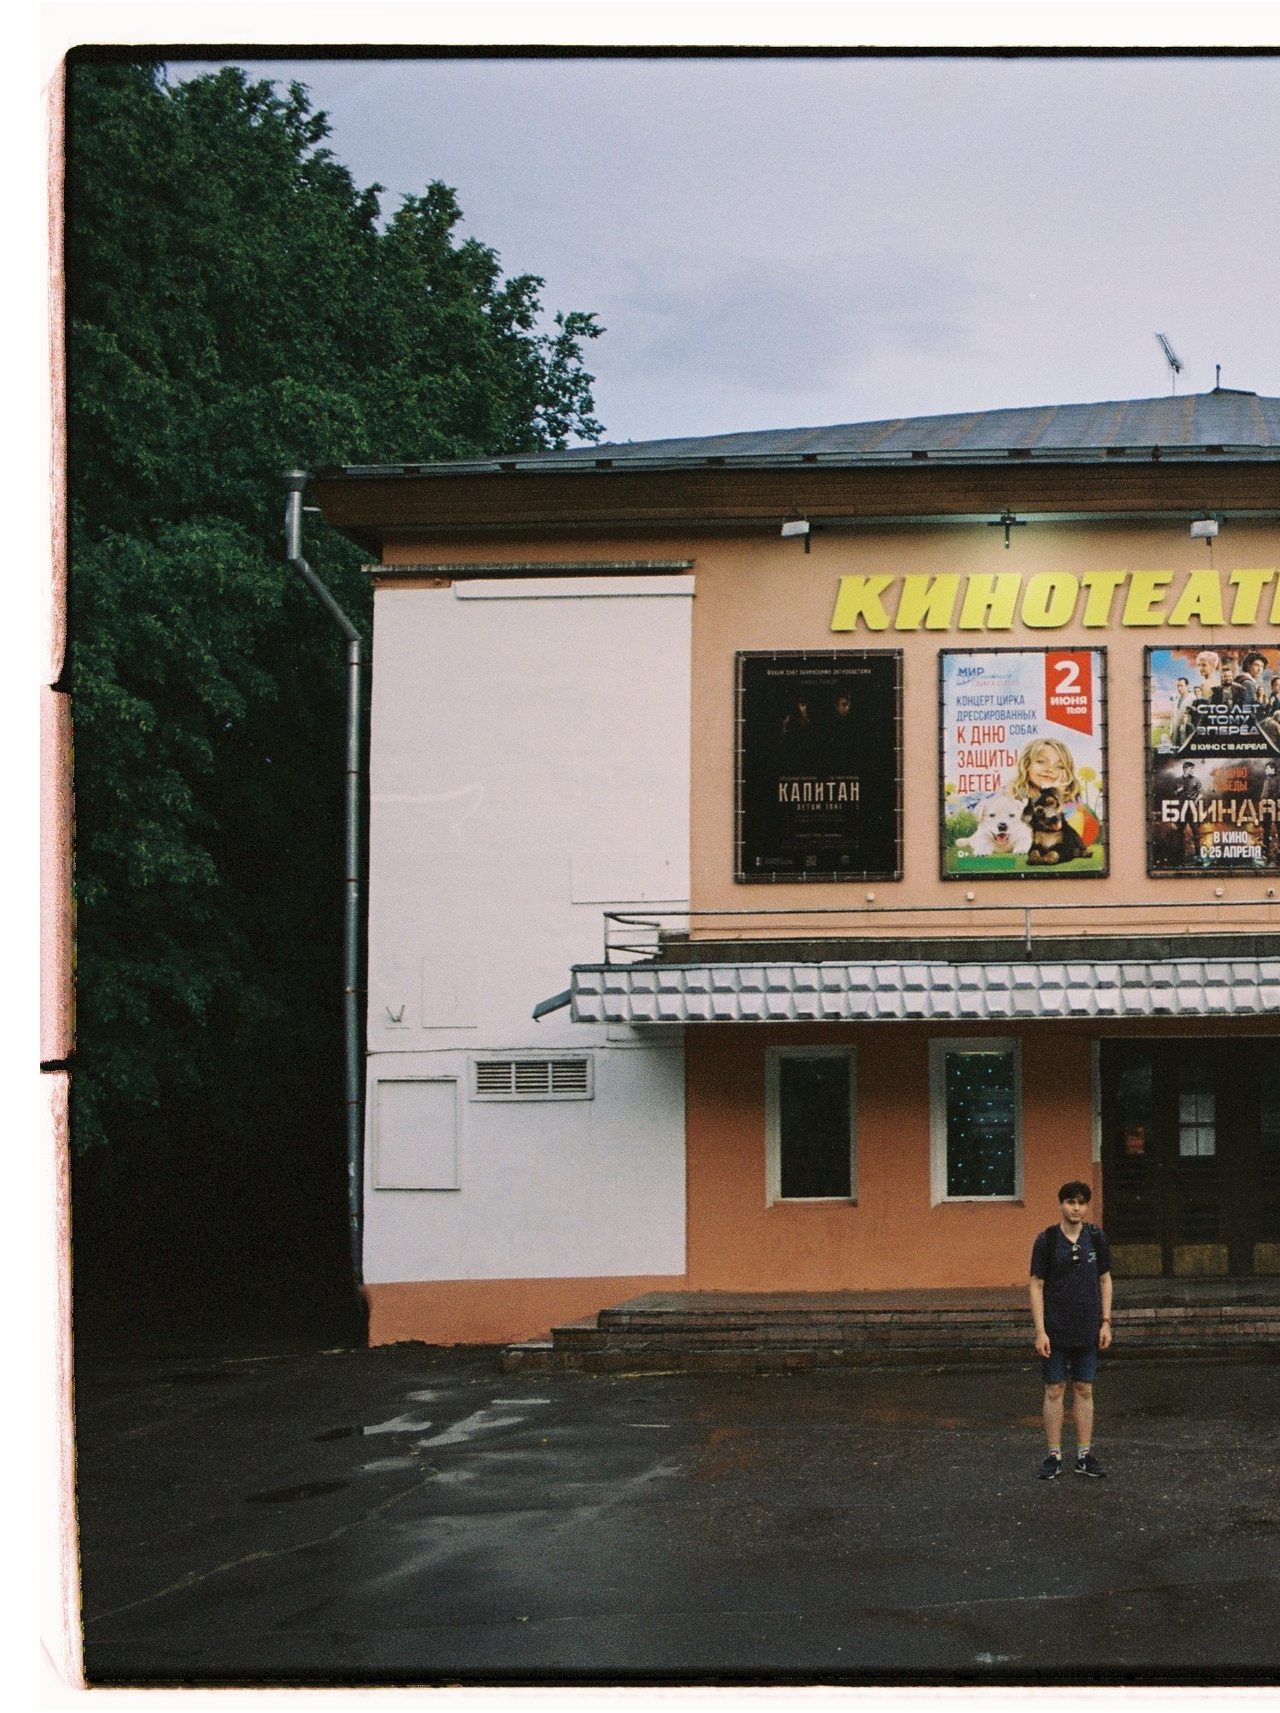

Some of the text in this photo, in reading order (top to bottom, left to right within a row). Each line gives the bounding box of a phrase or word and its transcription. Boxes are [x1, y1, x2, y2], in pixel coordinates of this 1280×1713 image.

[957, 667, 985, 677] МИР
[1053, 660, 1082, 694] 2
[956, 694, 1025, 707] КОНЦЕРТ ЦИРКА
[1050, 696, 1088, 706] ИЮНЯ
[1065, 706, 1088, 715] 11:00
[1196, 704, 1261, 714] СТО ЛЕТ
[956, 709, 1038, 722] ДРЕССИРОВАННЫХ
[1208, 715, 1250, 725] ТОМУ
[957, 725, 1006, 745] К ДНЮ
[1009, 724, 1039, 736] СОБАК
[1196, 725, 1260, 736] ВПЕРЁД
[1198, 743, 1220, 751] КИНО
[1236, 743, 1268, 751] АПРЕЛЯ
[957, 750, 1018, 769] ЗАЩИТЫ
[957, 771, 1001, 794] ДЕТЕЙ
[778, 782, 860, 802] КАПИТАН
[1213, 831, 1248, 844] В КИНО
[957, 850, 970, 859] 0+
[1200, 846, 1262, 858] С 25 АПРЕЛЯ
